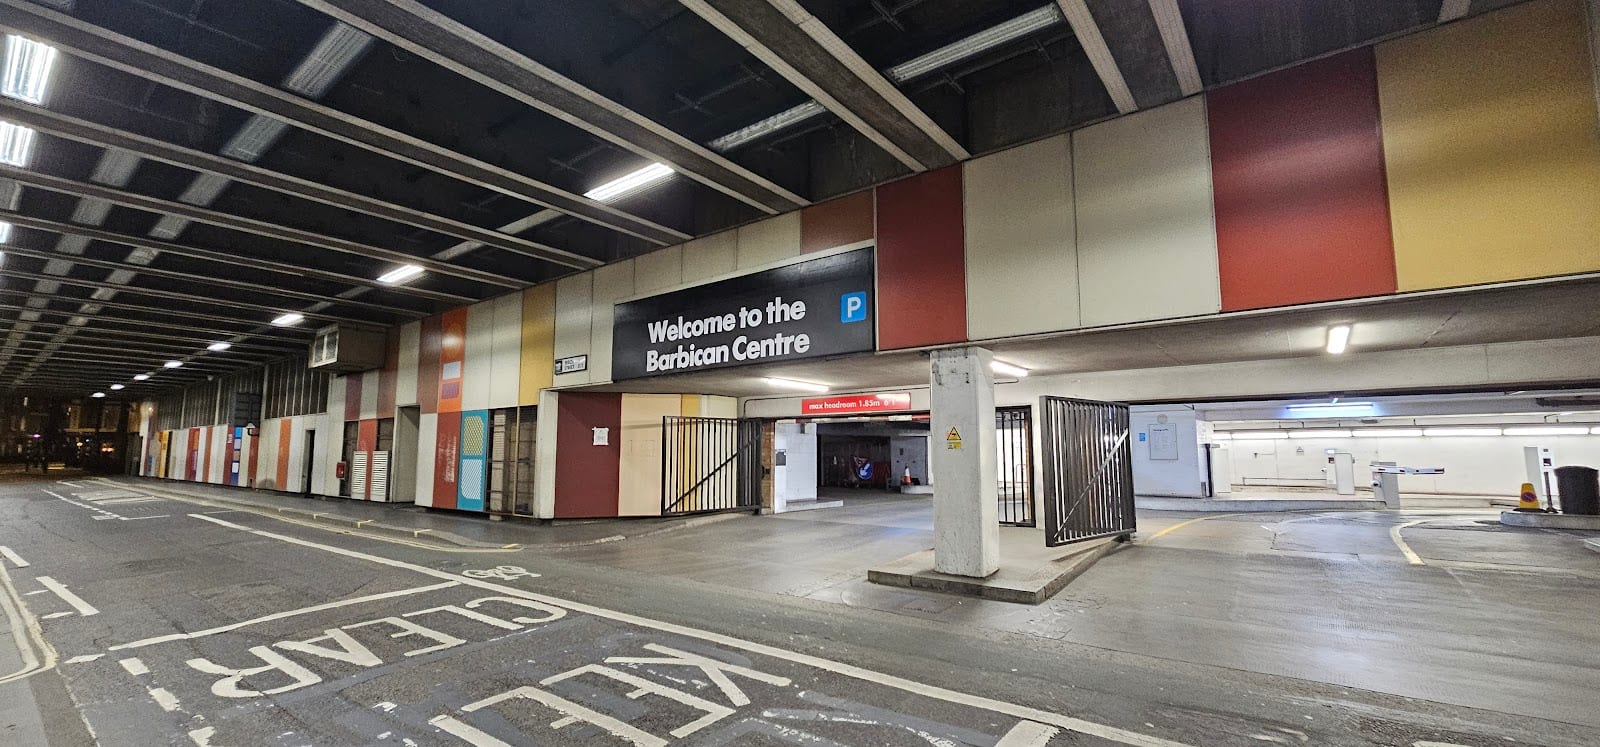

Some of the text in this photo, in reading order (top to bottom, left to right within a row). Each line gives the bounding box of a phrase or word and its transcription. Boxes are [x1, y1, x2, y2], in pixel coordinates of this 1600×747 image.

[648, 296, 806, 343] Welcome to the
[847, 296, 861, 318] P
[646, 333, 810, 372] Barbican Centre
[809, 402, 823, 410] max
[824, 400, 856, 409] headroom
[858, 399, 880, 408] 1.85m
[186, 596, 567, 697] CLEAR
